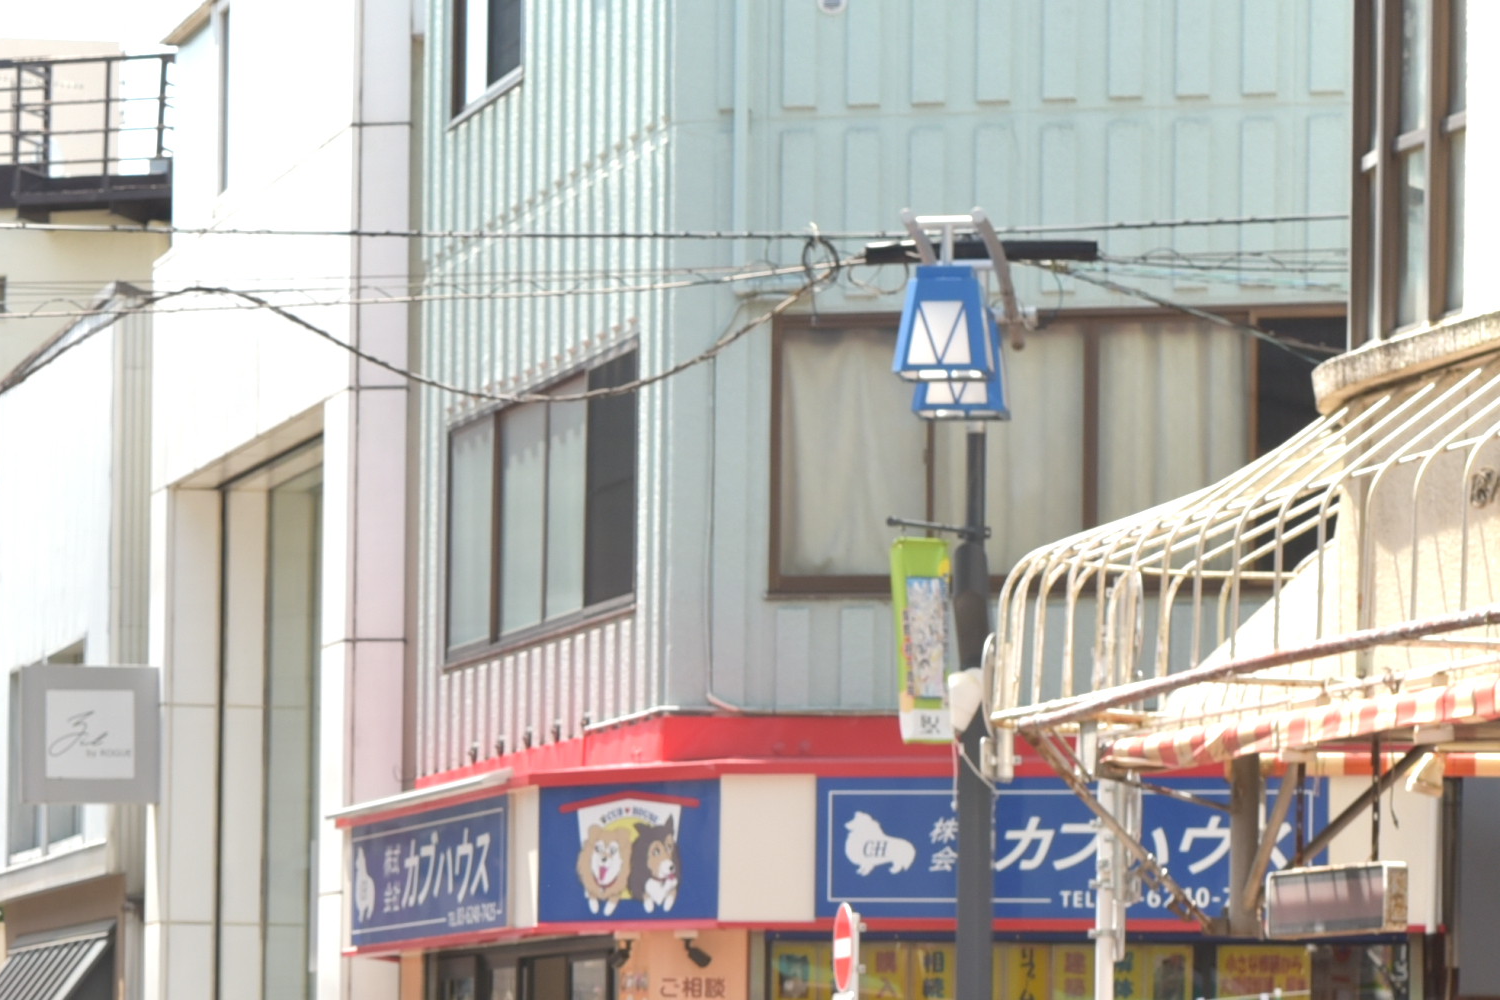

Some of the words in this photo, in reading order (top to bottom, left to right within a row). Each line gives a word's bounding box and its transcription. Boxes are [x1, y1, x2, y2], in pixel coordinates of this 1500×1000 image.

[401, 826, 490, 909] カブハウス
[660, 978, 725, 998] ご相談
